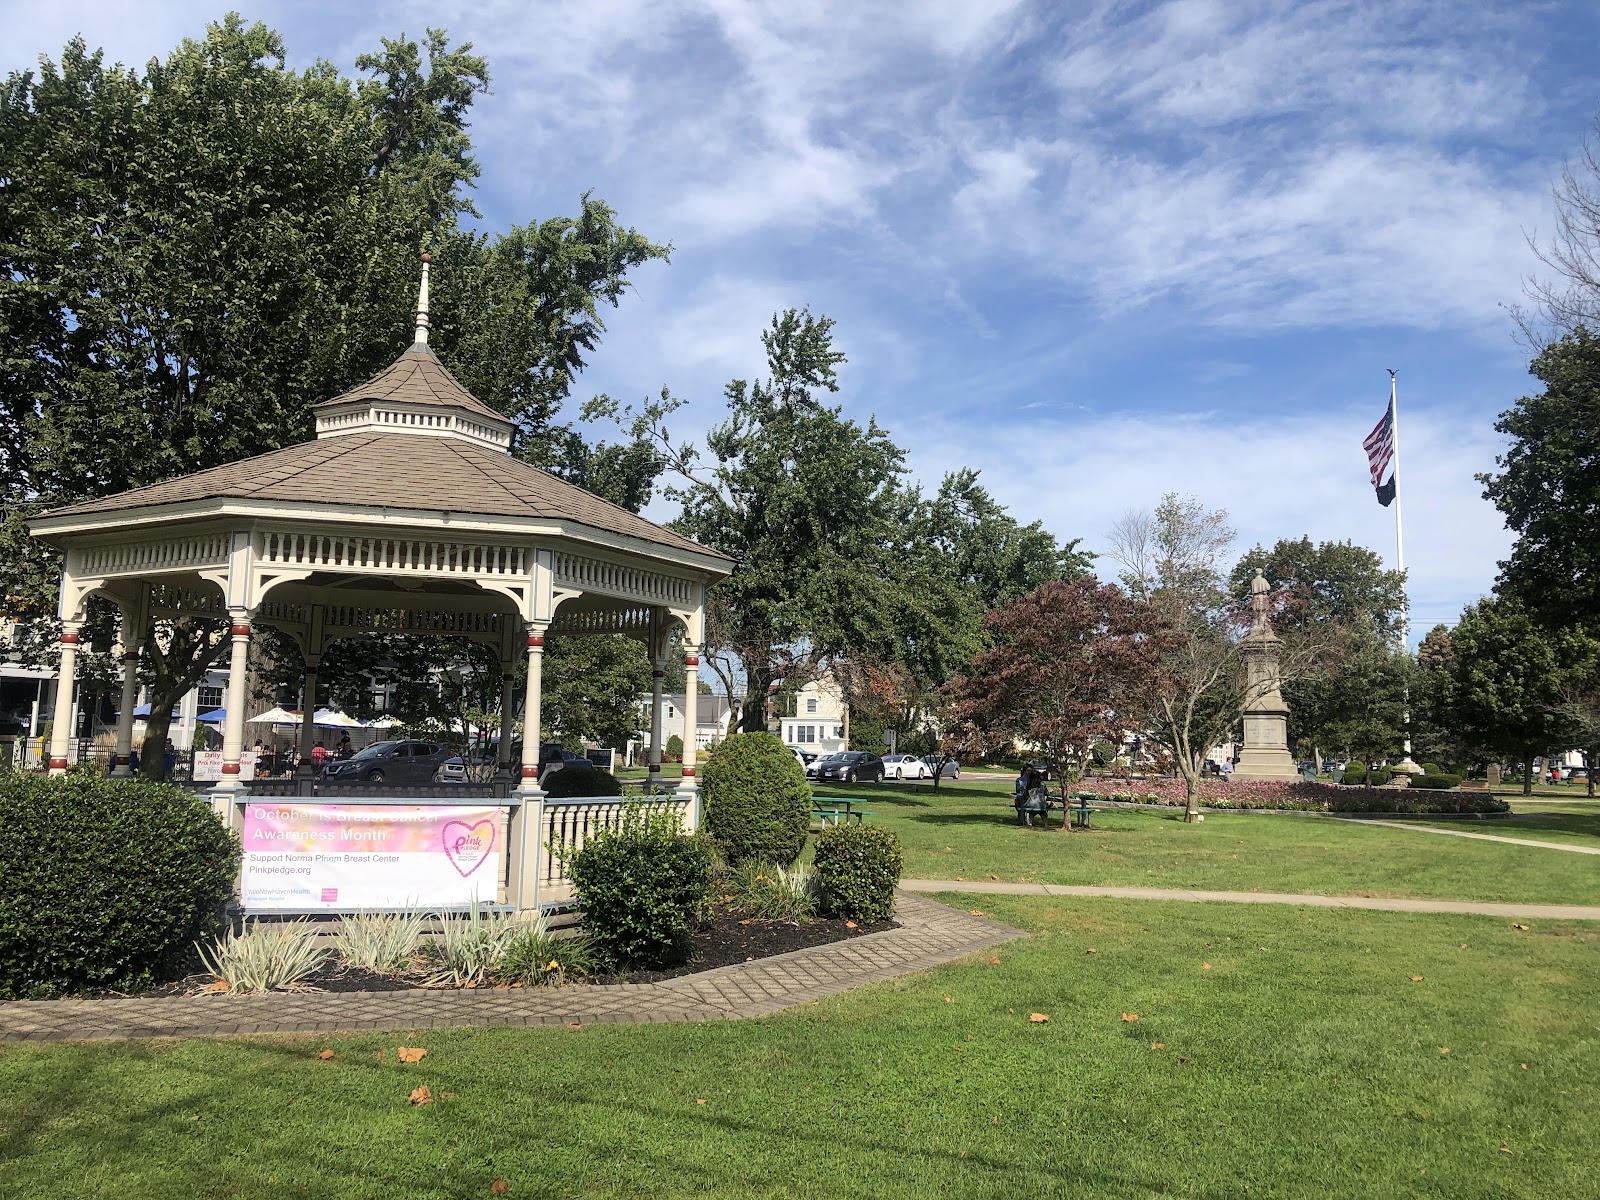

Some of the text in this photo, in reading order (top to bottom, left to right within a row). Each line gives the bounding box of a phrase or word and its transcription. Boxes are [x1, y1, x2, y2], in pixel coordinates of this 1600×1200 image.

[254, 808, 439, 822] October is Breast Cancer
[252, 827, 386, 841] Awareness Month
[249, 854, 283, 863] Support
[285, 854, 313, 862] Norma
[315, 854, 342, 862] Pfriem
[249, 866, 312, 875] Pinkpledge.org
